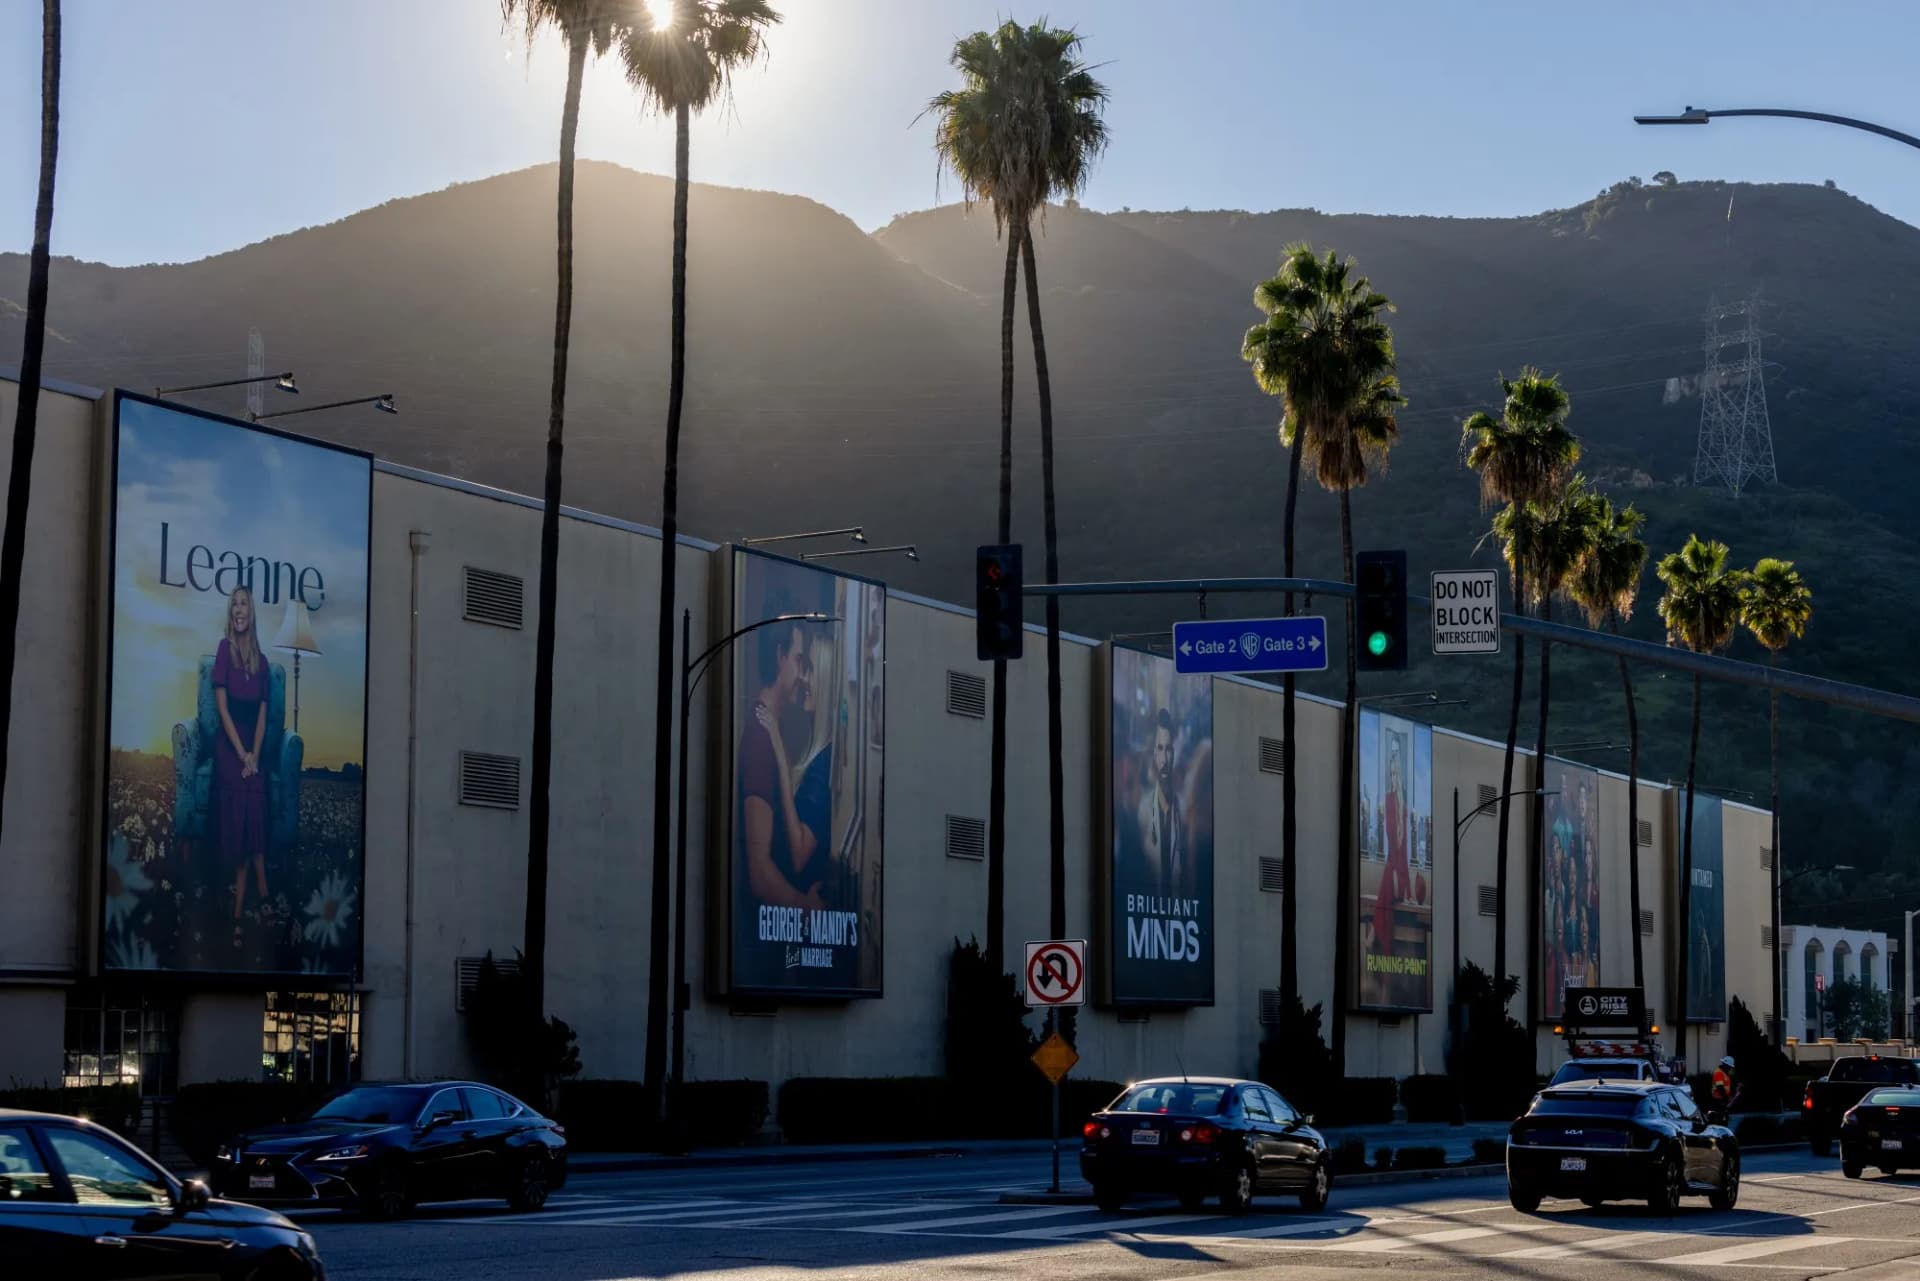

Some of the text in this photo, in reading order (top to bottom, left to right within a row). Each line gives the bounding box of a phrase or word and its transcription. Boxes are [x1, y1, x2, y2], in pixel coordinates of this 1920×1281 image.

[159, 521, 325, 612] Leanne
[1436, 580, 1493, 599] DO NOT
[1436, 606, 1494, 626] BLOCK
[1195, 639, 1237, 655] Gate 2
[1263, 635, 1305, 652] Gate 3
[1436, 630, 1496, 645] INTERSECTION
[1127, 893, 1200, 918] BRILLIANT
[759, 904, 804, 943] GEORGIE
[810, 909, 858, 947] MANDY'S
[1127, 916, 1200, 963] MINDS
[801, 947, 833, 968] MARRIAGE
[1367, 953, 1427, 976] RUNNING POINT
